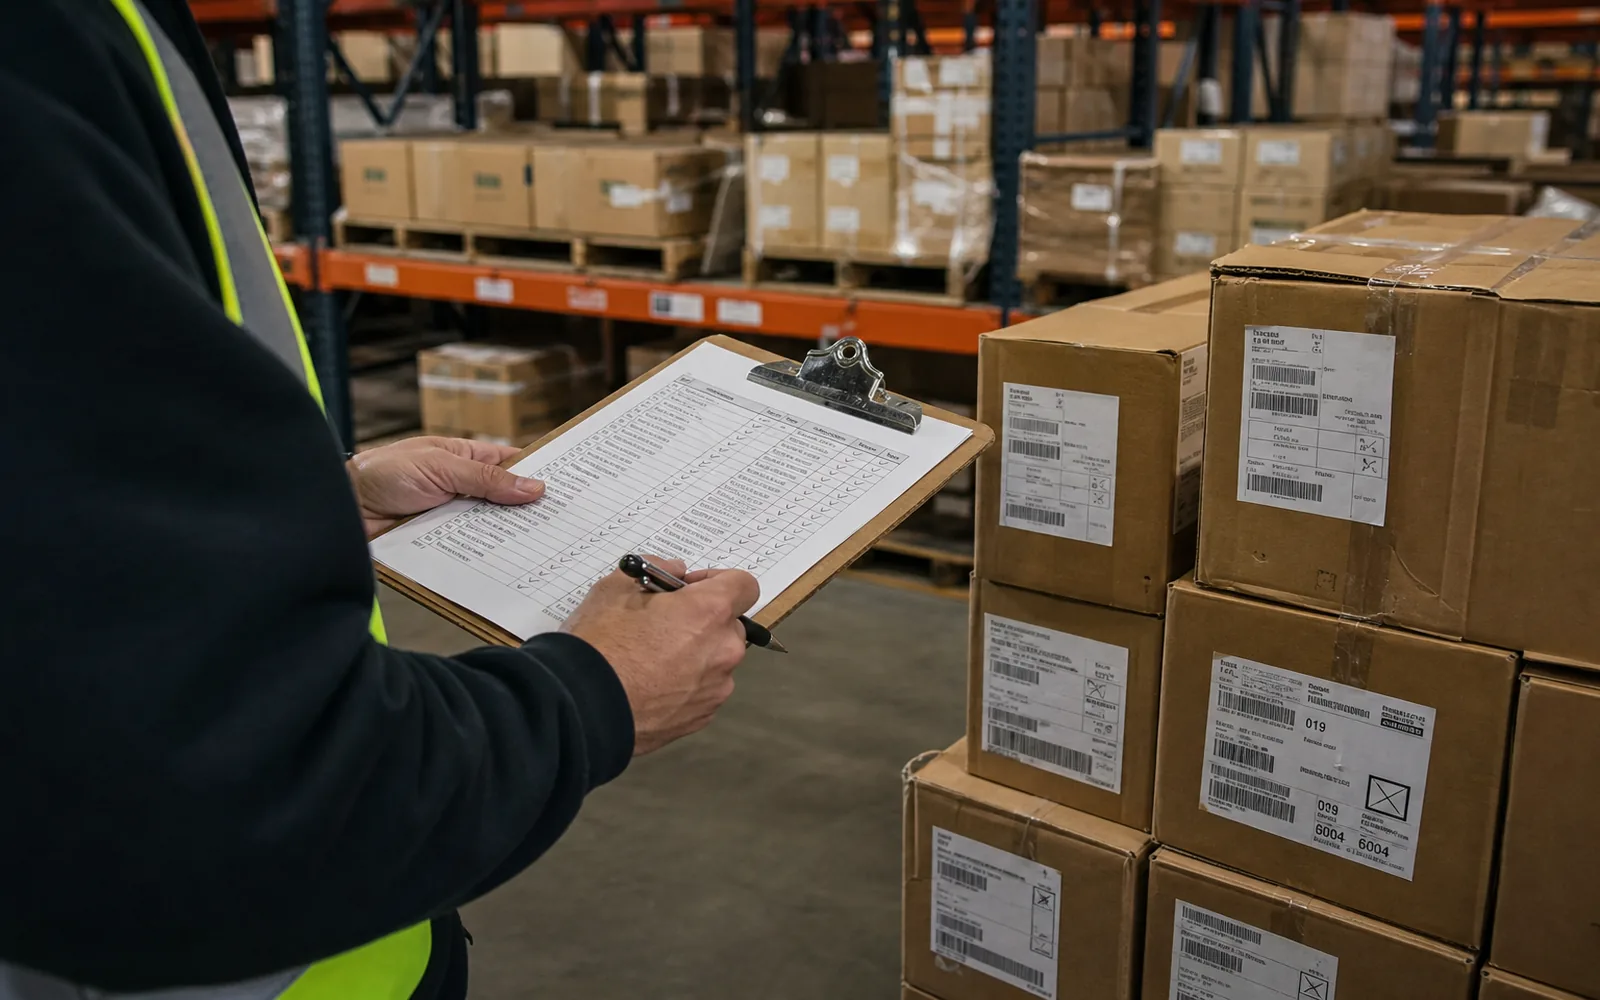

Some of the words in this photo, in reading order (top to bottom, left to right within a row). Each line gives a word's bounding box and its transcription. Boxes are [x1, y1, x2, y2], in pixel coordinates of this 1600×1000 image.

[1305, 718, 1326, 733] 019
[1315, 823, 1346, 843] 6004
[1358, 838, 1390, 858] 6004
